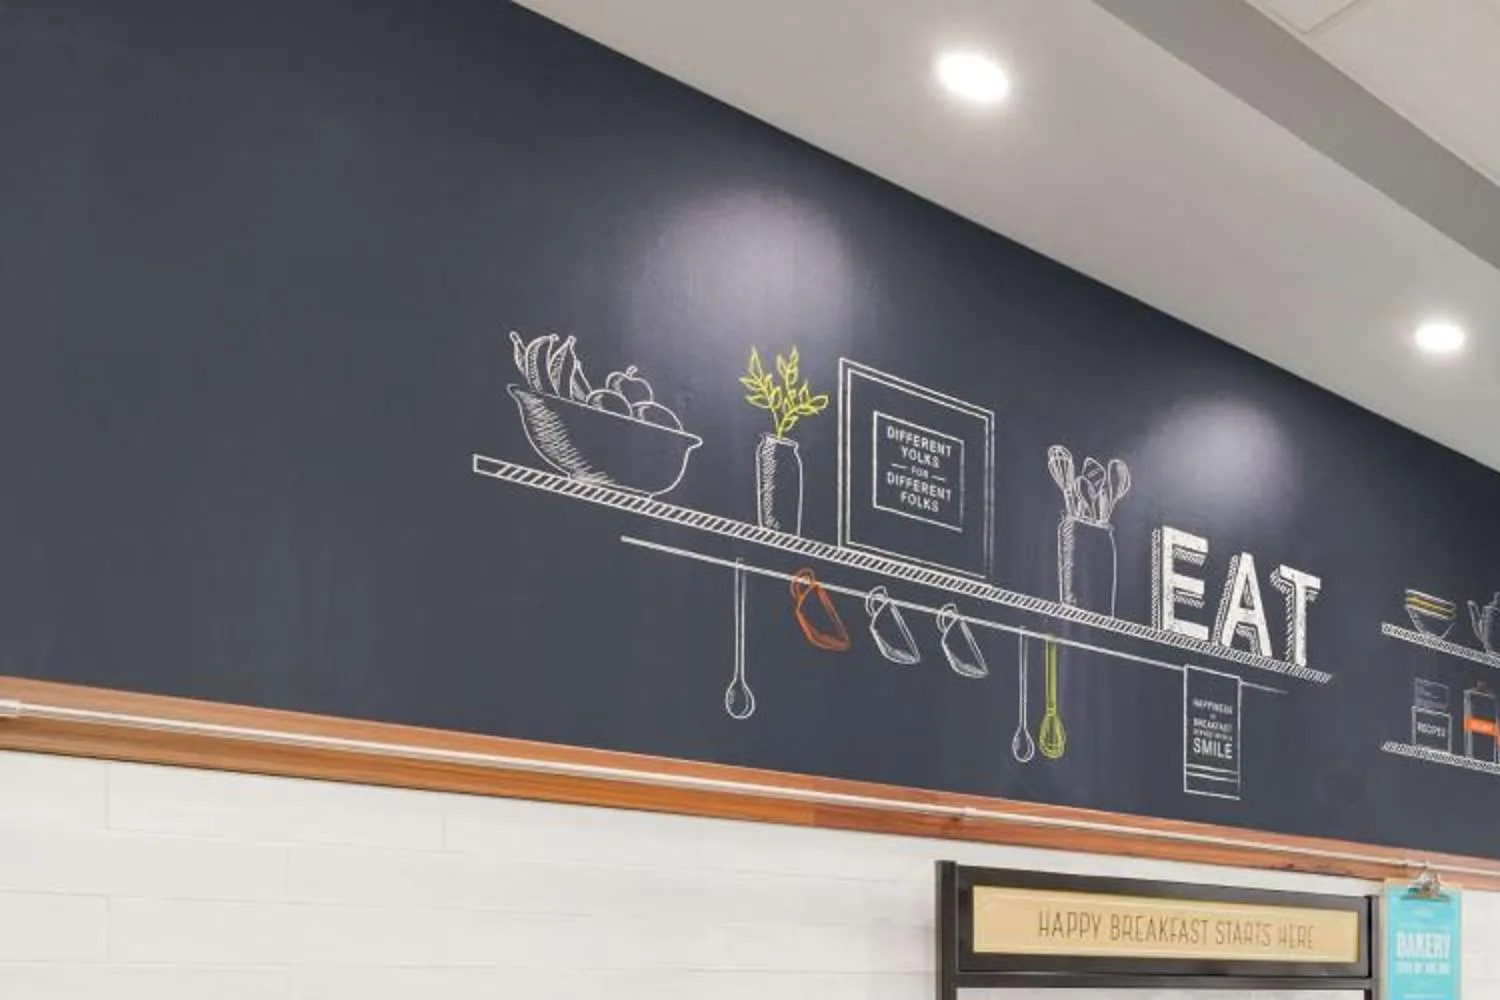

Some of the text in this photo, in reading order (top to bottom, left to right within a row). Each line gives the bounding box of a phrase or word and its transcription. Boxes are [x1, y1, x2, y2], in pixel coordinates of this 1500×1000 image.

[887, 425, 952, 457] DIFFERENT
[901, 446, 940, 468] YOLKS
[887, 471, 952, 501] DIFFERENT
[901, 491, 940, 513] FOLKS
[1151, 525, 1321, 667] EAT
[1193, 737, 1233, 759] SMILE
[1038, 911, 1316, 949] HAPPY BREAKFAST STARTS HERE
[1396, 930, 1451, 960] BAKERY
